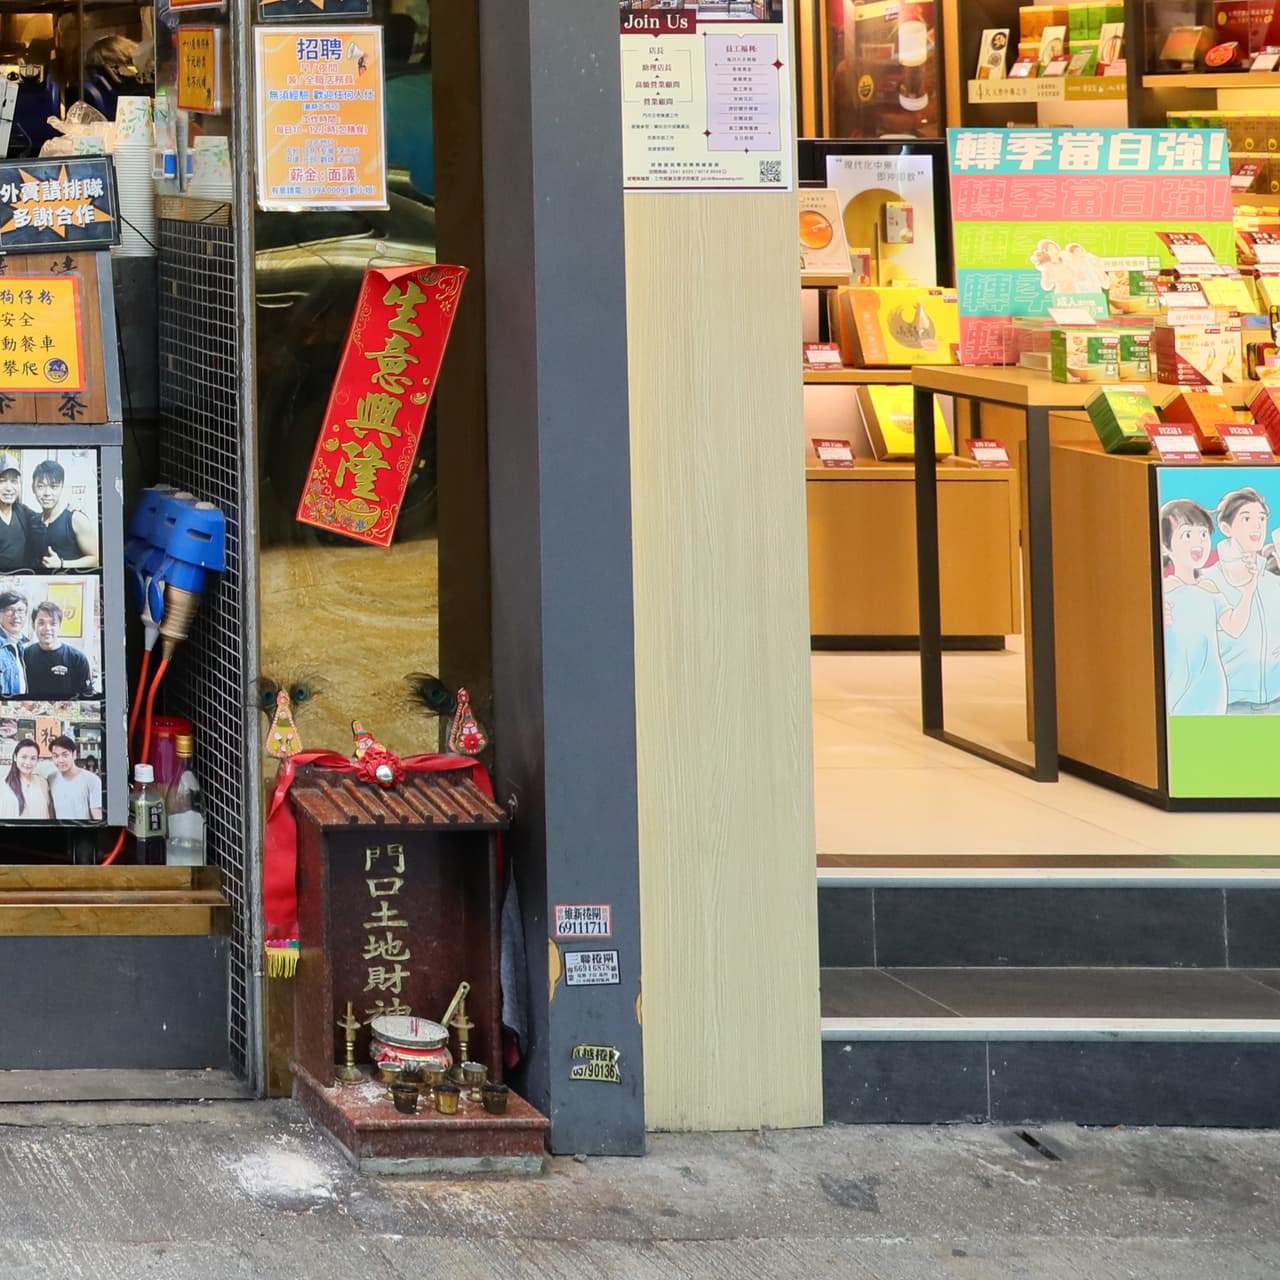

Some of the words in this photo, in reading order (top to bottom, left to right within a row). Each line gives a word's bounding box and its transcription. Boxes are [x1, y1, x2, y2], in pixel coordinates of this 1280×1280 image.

[624, 14, 660, 30] Join
[666, 14, 689, 29] Us
[297, 38, 343, 61] 招聘
[954, 131, 1225, 171] 轉季當自強!
[0, 176, 105, 204] 外賣請排隊
[957, 178, 1230, 219] 轉季當自強!
[12, 203, 97, 228] 多謝合作
[335, 280, 428, 502] 生意興隆
[362, 842, 412, 1022] 門口土地財神
[558, 921, 609, 934] 69111711
